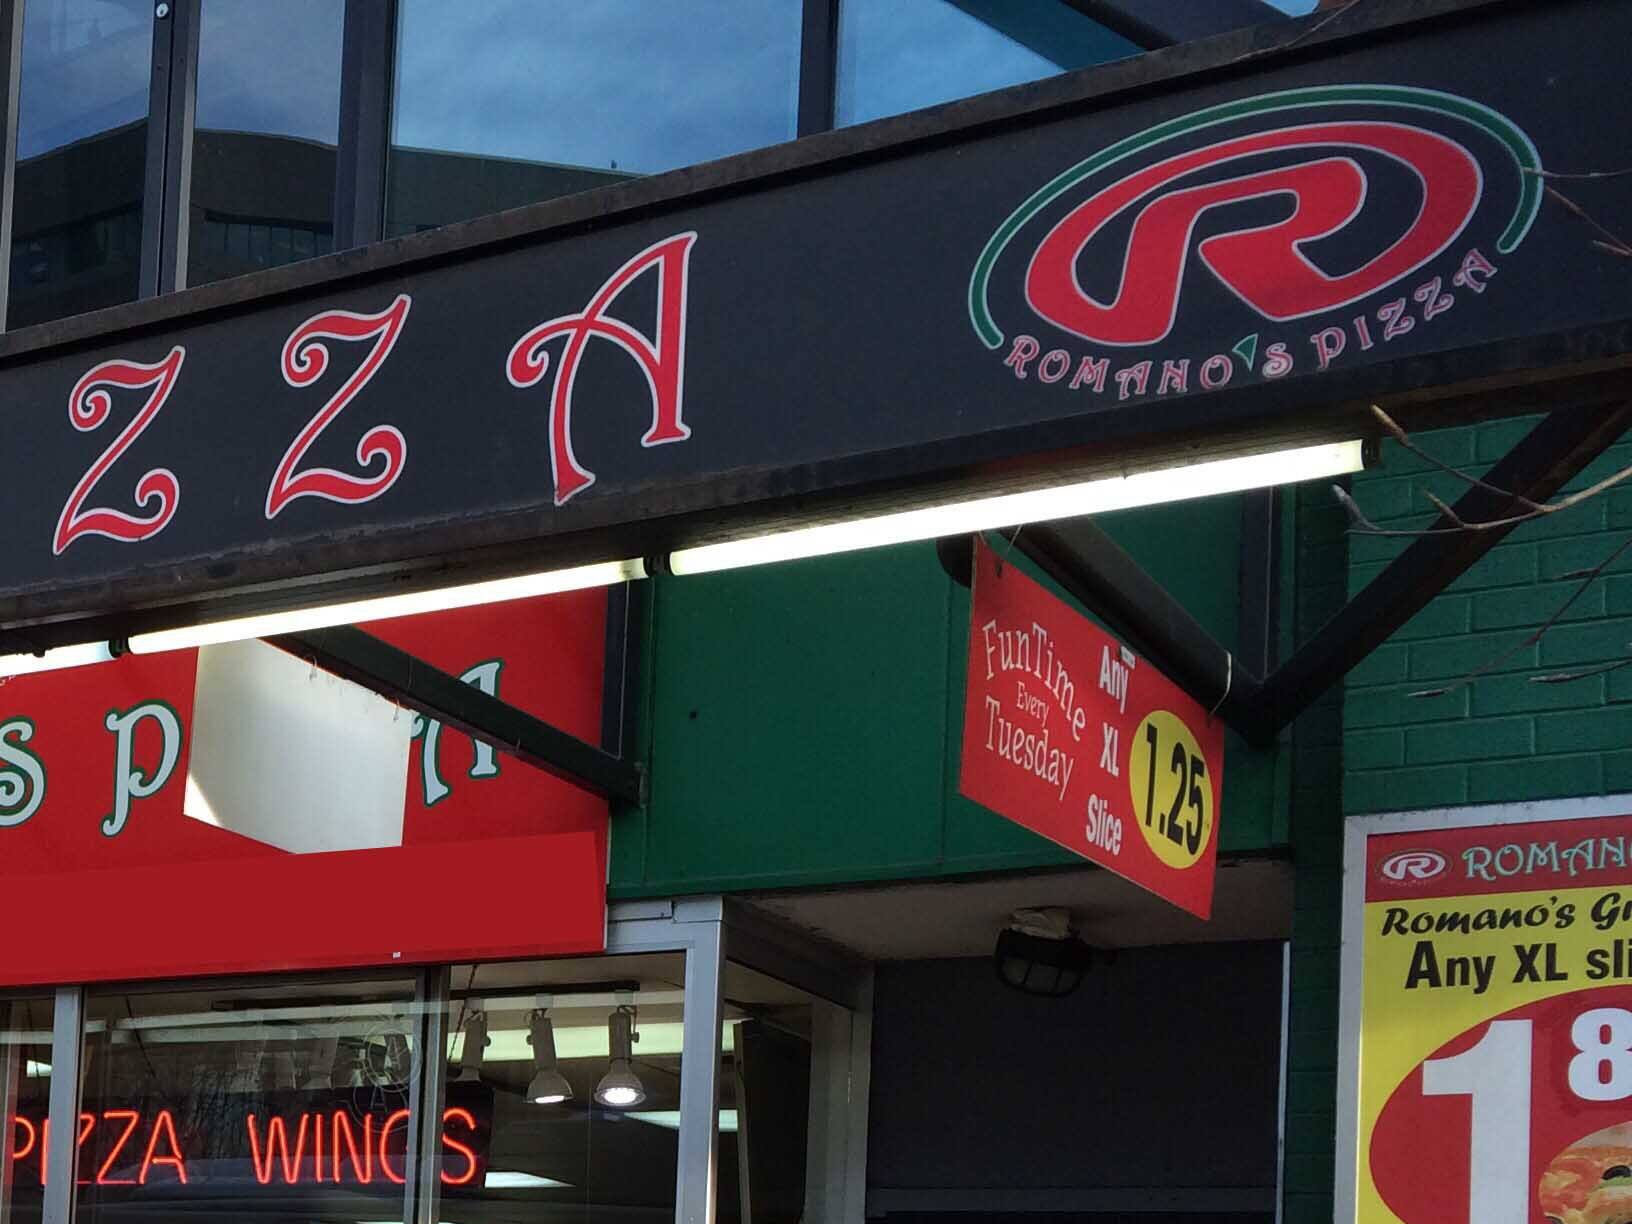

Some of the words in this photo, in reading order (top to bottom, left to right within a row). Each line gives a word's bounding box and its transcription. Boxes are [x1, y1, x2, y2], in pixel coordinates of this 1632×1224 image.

[1004, 333, 1293, 400] ROMANO'S
[1311, 248, 1498, 368] PIZZA
[1017, 681, 1050, 729] Every
[1099, 645, 1129, 715] Any
[985, 696, 1074, 801] Tuesday
[1100, 722, 1120, 777] XL
[1147, 723, 1205, 856] 1.25
[1086, 793, 1123, 856] Slice
[1462, 836, 1632, 882] ROMAN
[1381, 896, 1575, 937] Romano's
[1405, 940, 1495, 994] Any
[1513, 943, 1568, 984] XL
